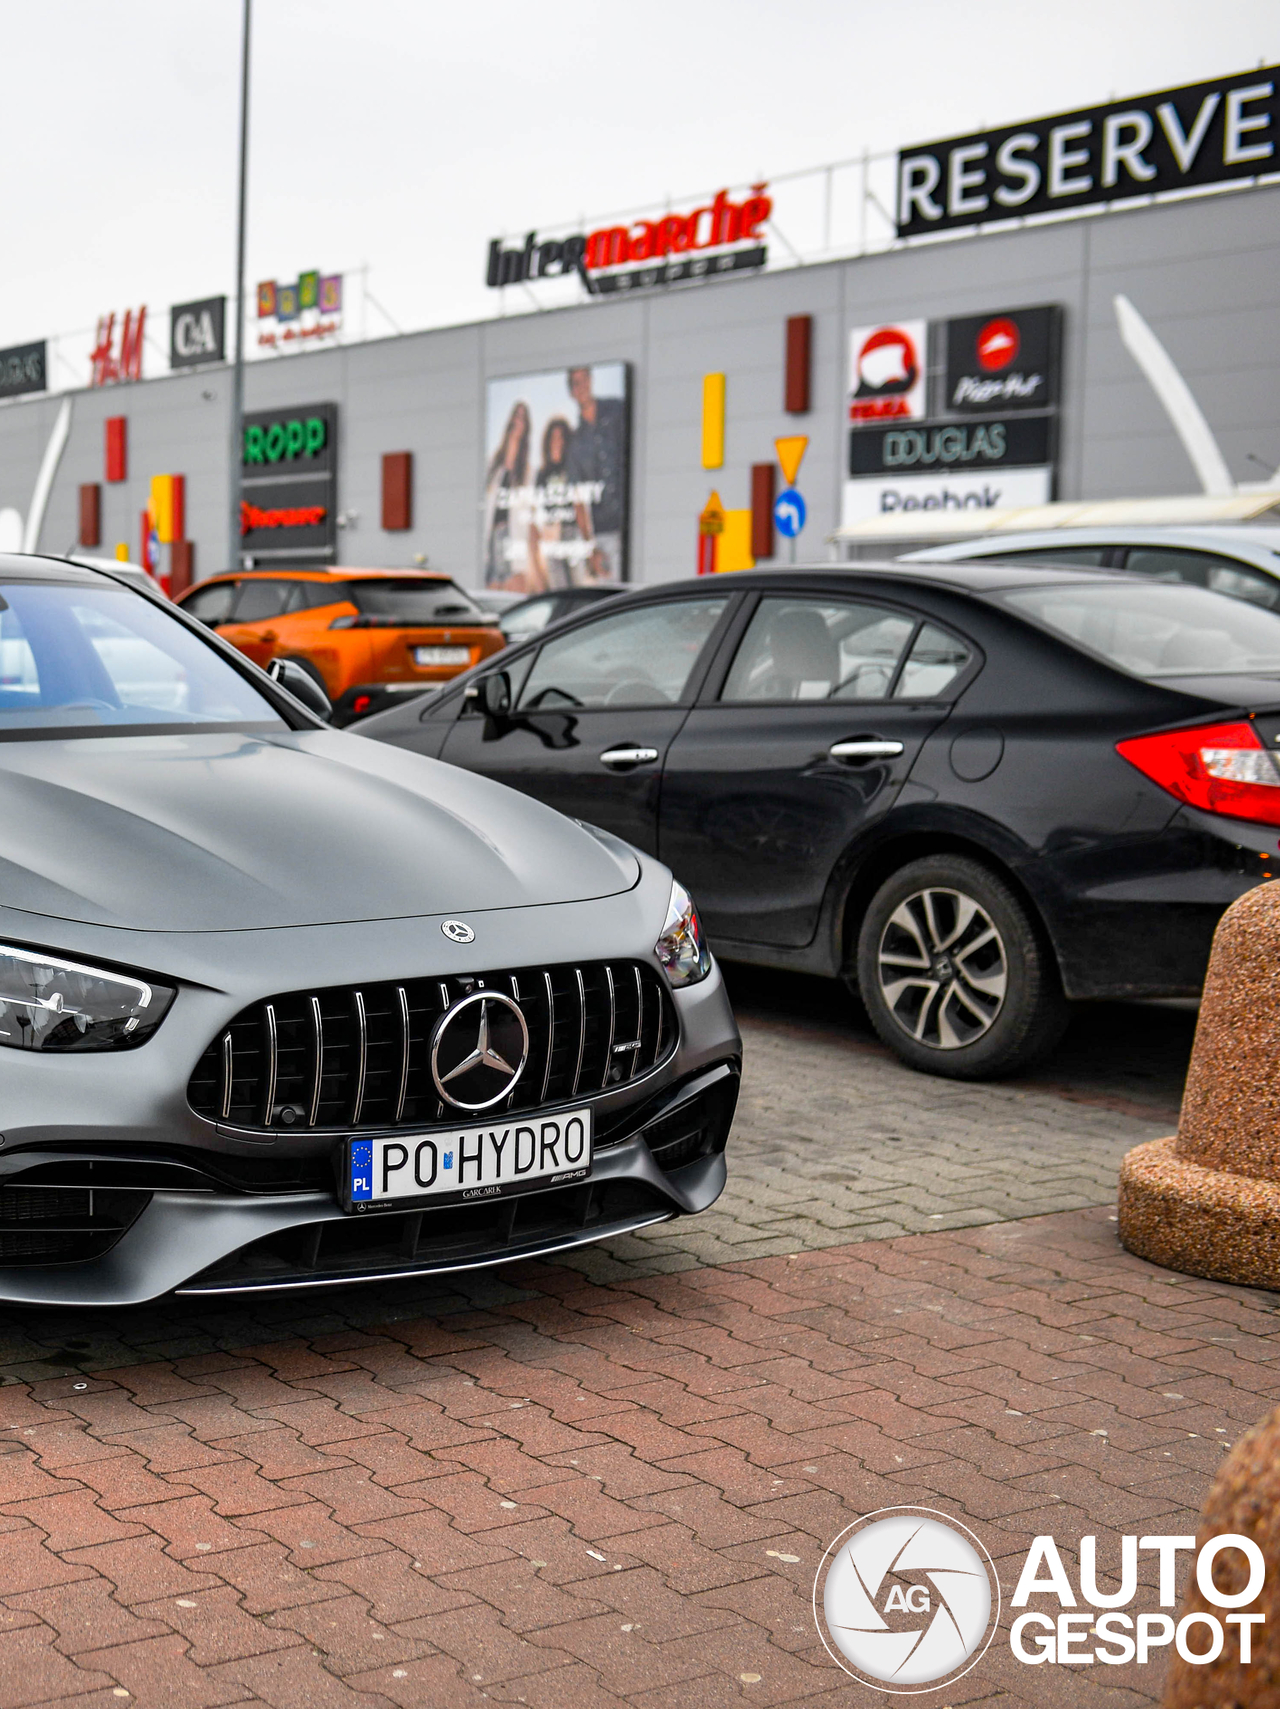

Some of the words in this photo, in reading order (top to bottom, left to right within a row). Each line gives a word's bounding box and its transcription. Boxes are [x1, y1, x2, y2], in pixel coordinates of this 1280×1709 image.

[244, 417, 326, 463] ROPP
[883, 423, 1006, 465] DOUGLAS
[881, 483, 1002, 514] Reebok
[382, 1139, 438, 1193] PO
[458, 1117, 585, 1183] HYDRO
[353, 1178, 370, 1192] PL
